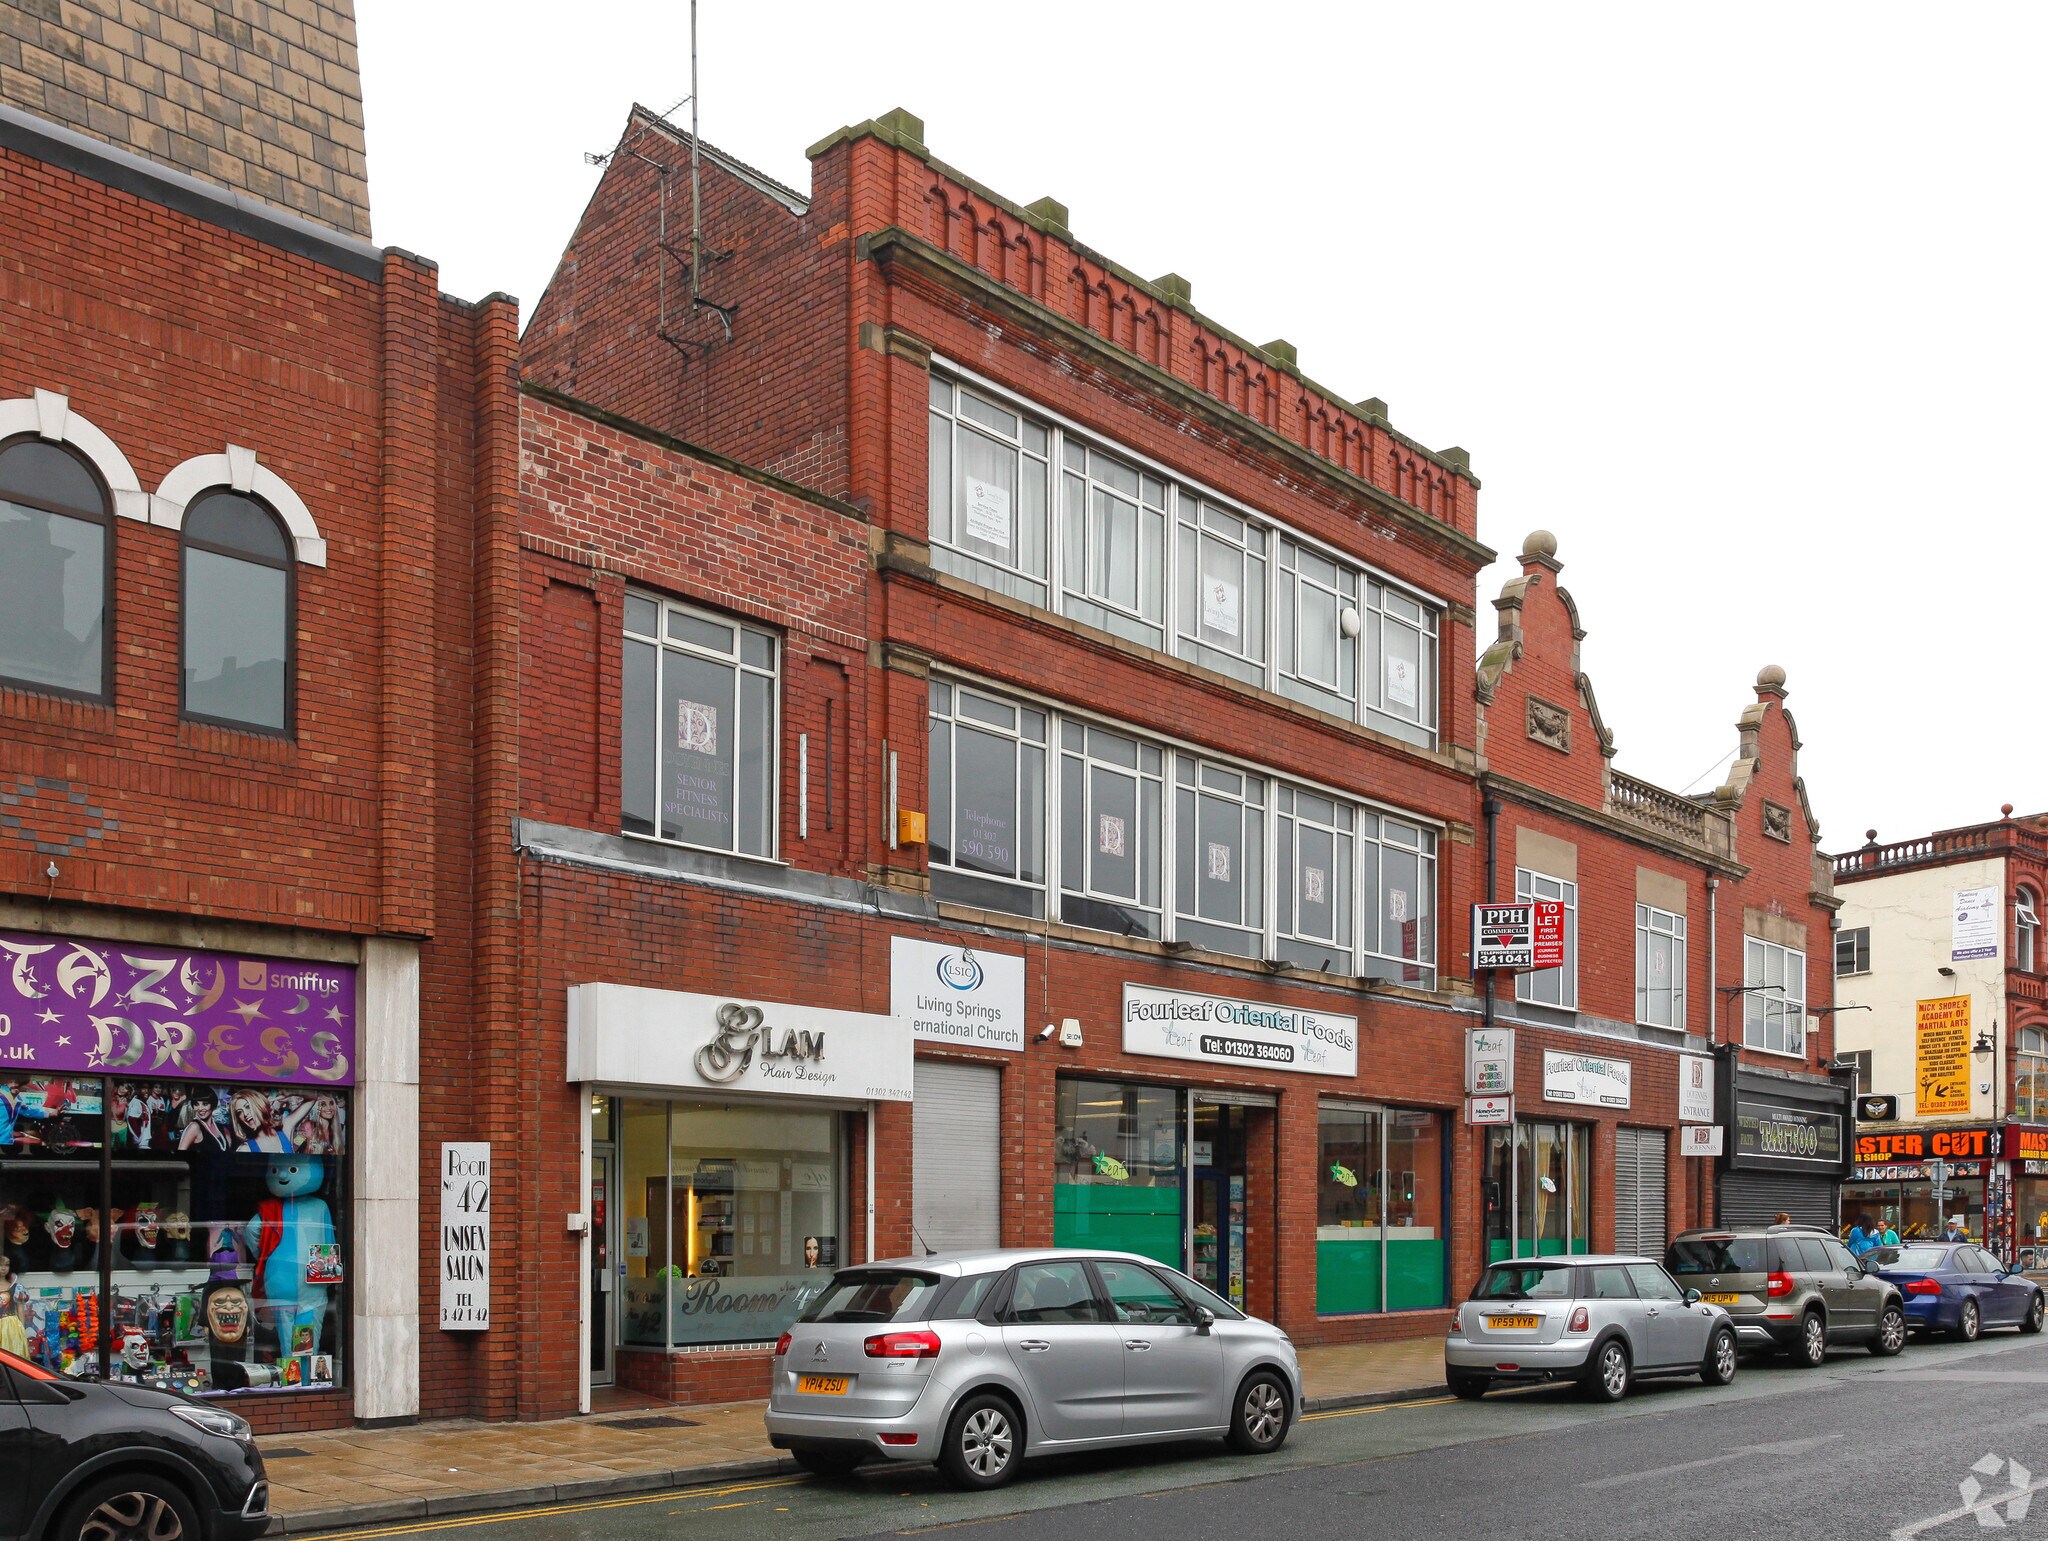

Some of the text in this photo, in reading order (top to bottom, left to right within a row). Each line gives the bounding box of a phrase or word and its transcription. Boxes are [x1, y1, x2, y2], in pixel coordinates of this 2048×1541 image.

[677, 773, 716, 791] SENIOR
[677, 788, 718, 806] FITNESS
[665, 801, 729, 824] SPECIALISTS
[963, 809, 1006, 829] Telephone
[972, 828, 997, 841] 01302
[962, 840, 1009, 862] 590 590
[1486, 909, 1524, 923] PPH
[1541, 904, 1557, 913] TO
[1537, 916, 1560, 925] LET
[1480, 955, 1529, 963] 341041
[949, 966, 971, 977] LSIC
[270, 972, 339, 998] smiffys
[917, 995, 1001, 1022] Living Springs
[1939, 1000, 1967, 1010] SHORE'S
[1918, 1019, 1968, 1030] MARTIAL ARTS
[1922, 1011, 1952, 1020] ACADEMY
[914, 1020, 1019, 1042] ernational Church
[1128, 999, 1353, 1051] Fourleaf Oriental Foods
[0, 1043, 35, 1060] .uk
[86, 1015, 349, 1081] DRESS
[1205, 1039, 1291, 1061] Tel: 01302 364060
[760, 1062, 837, 1086] Hair Design
[1546, 1057, 1628, 1085] Fourleaf Oriental Foods
[866, 1087, 887, 1096] 01302
[1683, 1106, 1710, 1118] ENTRANCE
[1759, 1121, 1817, 1155] TATTOO
[1932, 1131, 1987, 1157] CUT
[2020, 1132, 2048, 1150] MAS
[448, 1150, 488, 1176] Room
[1863, 1152, 1892, 1161] SHOP
[2020, 1150, 2039, 1158] BARBER
[457, 1180, 489, 1212] 42
[444, 1226, 486, 1251] UNISEX
[446, 1255, 484, 1281] SALON
[456, 1293, 474, 1306] TEL
[682, 1277, 787, 1315] Room
[1718, 1294, 1734, 1302] UPV
[1491, 1317, 1534, 1327] YP59 YYR
[805, 1377, 844, 1391] YP14 ZSU
